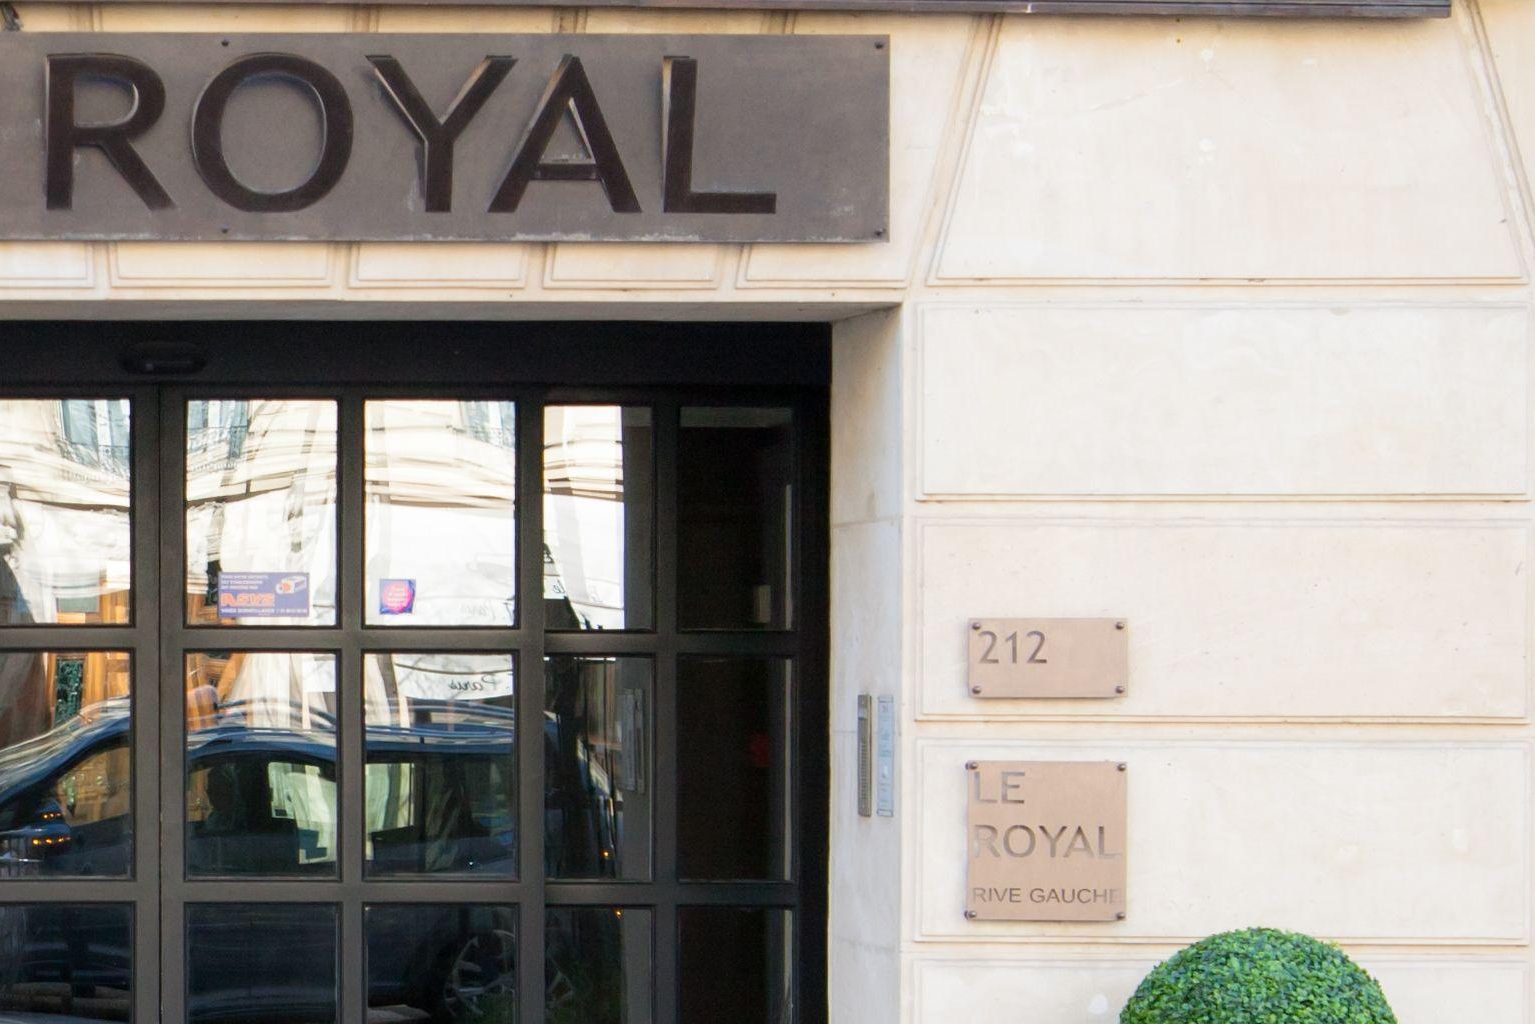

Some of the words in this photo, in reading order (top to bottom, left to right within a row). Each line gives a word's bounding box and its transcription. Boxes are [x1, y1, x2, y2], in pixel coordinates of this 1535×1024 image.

[45, 51, 778, 214] ROYAL
[977, 630, 1048, 664] 212
[973, 771, 1026, 805] LE
[973, 824, 1122, 859] ROYAL
[972, 887, 1022, 903] RIVE
